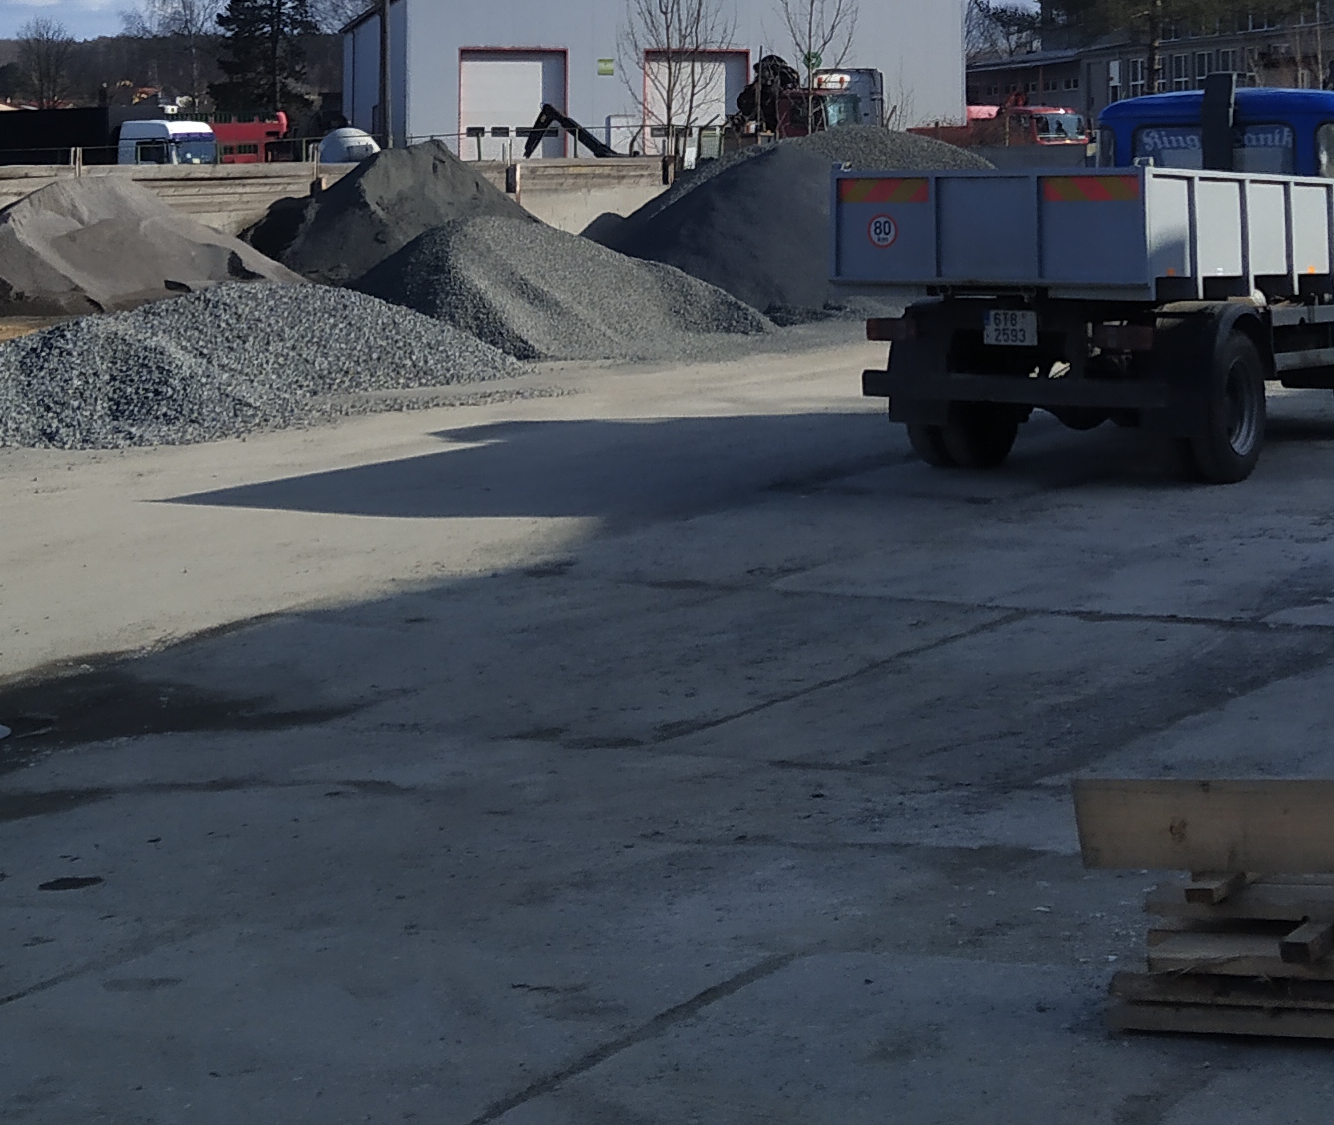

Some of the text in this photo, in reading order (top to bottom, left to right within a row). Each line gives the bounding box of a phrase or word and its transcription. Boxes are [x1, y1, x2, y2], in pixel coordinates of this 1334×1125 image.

[1142, 128, 1201, 151] King
[873, 220, 892, 236] 80
[993, 312, 1018, 327] 6T8
[993, 328, 1027, 343] 2593
